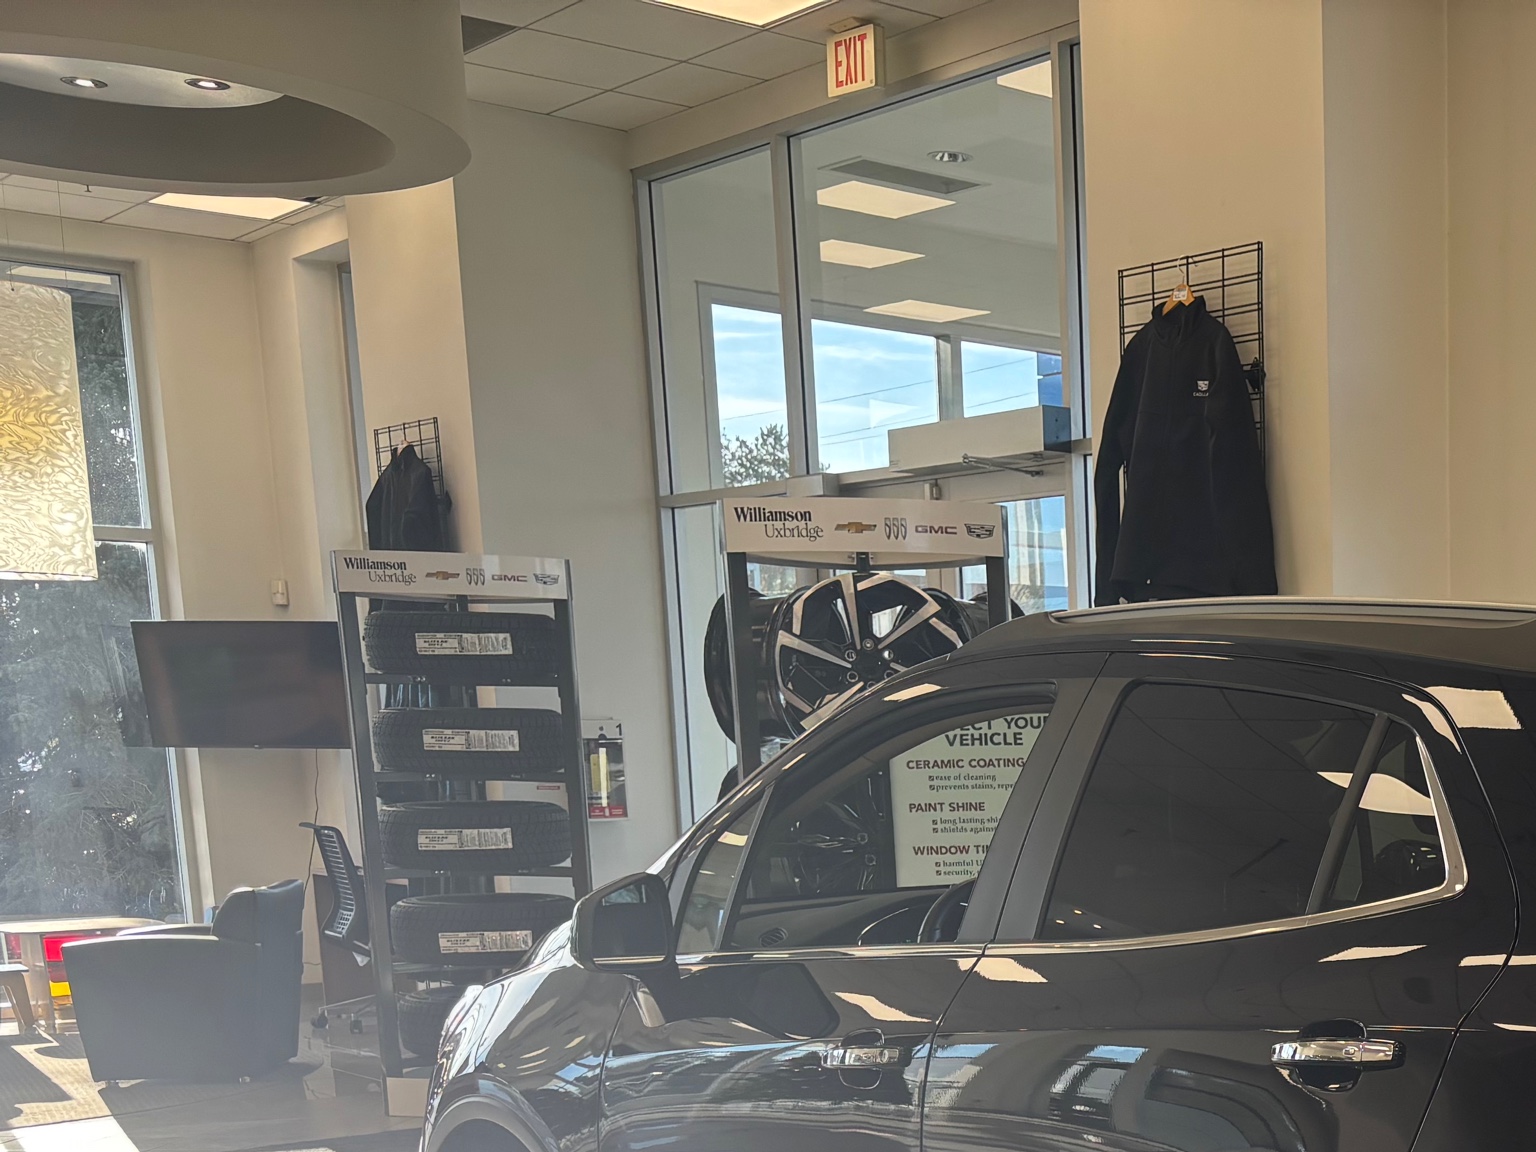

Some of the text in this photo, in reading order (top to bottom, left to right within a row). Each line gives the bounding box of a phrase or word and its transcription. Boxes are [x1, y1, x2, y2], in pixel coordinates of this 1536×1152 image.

[834, 32, 867, 89] EXIT
[733, 506, 812, 523] Williamson
[764, 522, 824, 542] Uxbridge
[915, 525, 957, 535] GMC
[343, 557, 407, 571] Williamson
[368, 571, 417, 586] Uxbridge
[491, 574, 528, 583] GMC
[945, 732, 1023, 747] VEHICLE
[906, 757, 1025, 770] CERAMIC COATING
[953, 773, 961, 781] of
[963, 773, 996, 782] cleaning
[936, 784, 969, 792] prevents
[909, 802, 985, 813] PAINT SHINE
[940, 818, 957, 826] long
[958, 816, 985, 825] lasting
[913, 845, 970, 856] WINDOW
